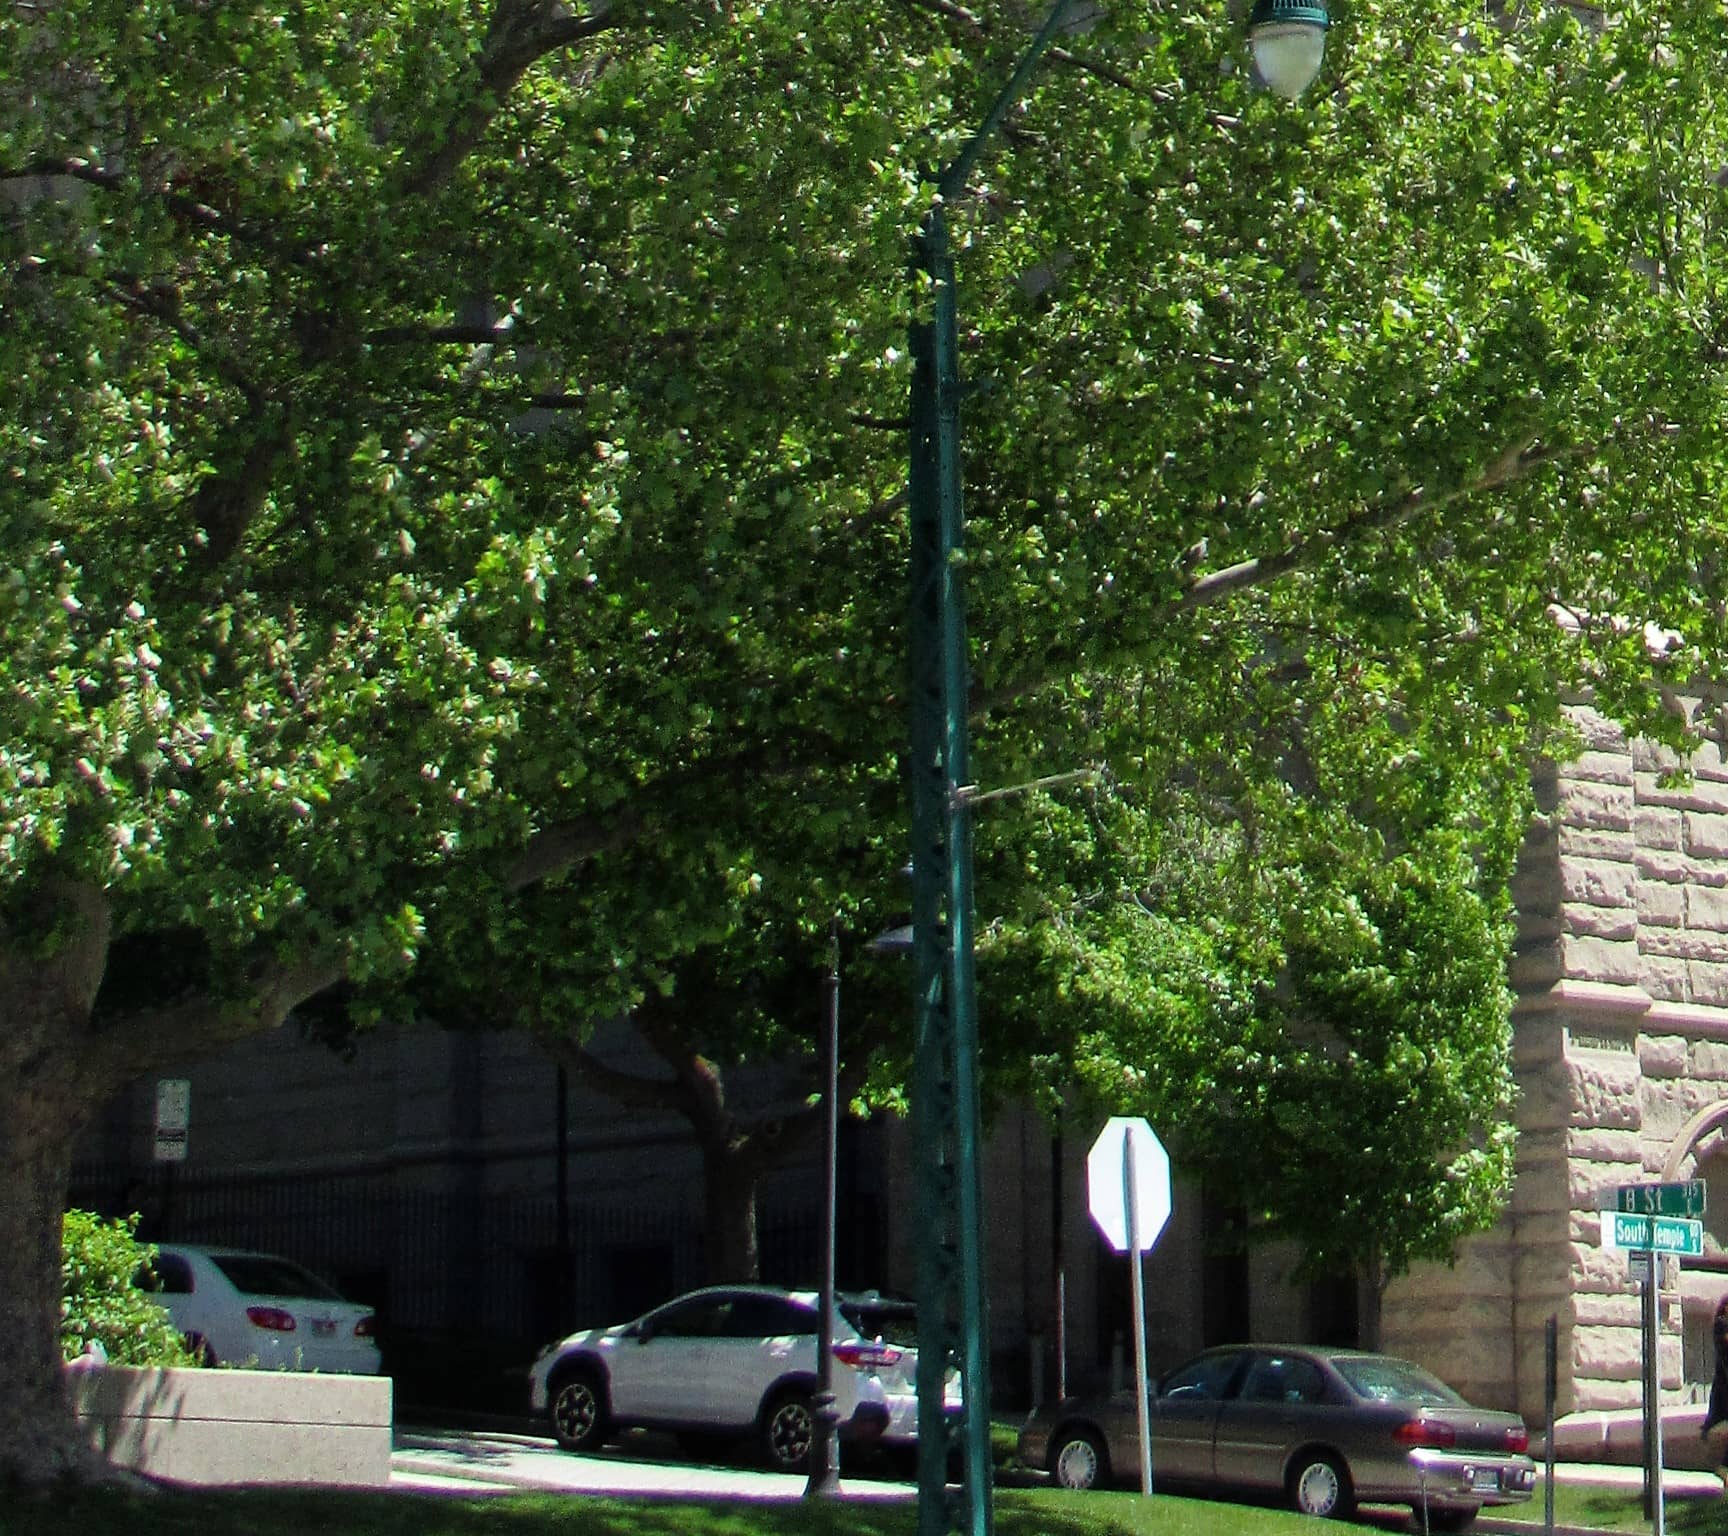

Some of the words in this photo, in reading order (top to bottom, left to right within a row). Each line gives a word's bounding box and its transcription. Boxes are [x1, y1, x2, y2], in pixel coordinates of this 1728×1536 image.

[1645, 1183, 1663, 1212] St
[1616, 1219, 1649, 1242] South
[1653, 1222, 1685, 1249] Temple
